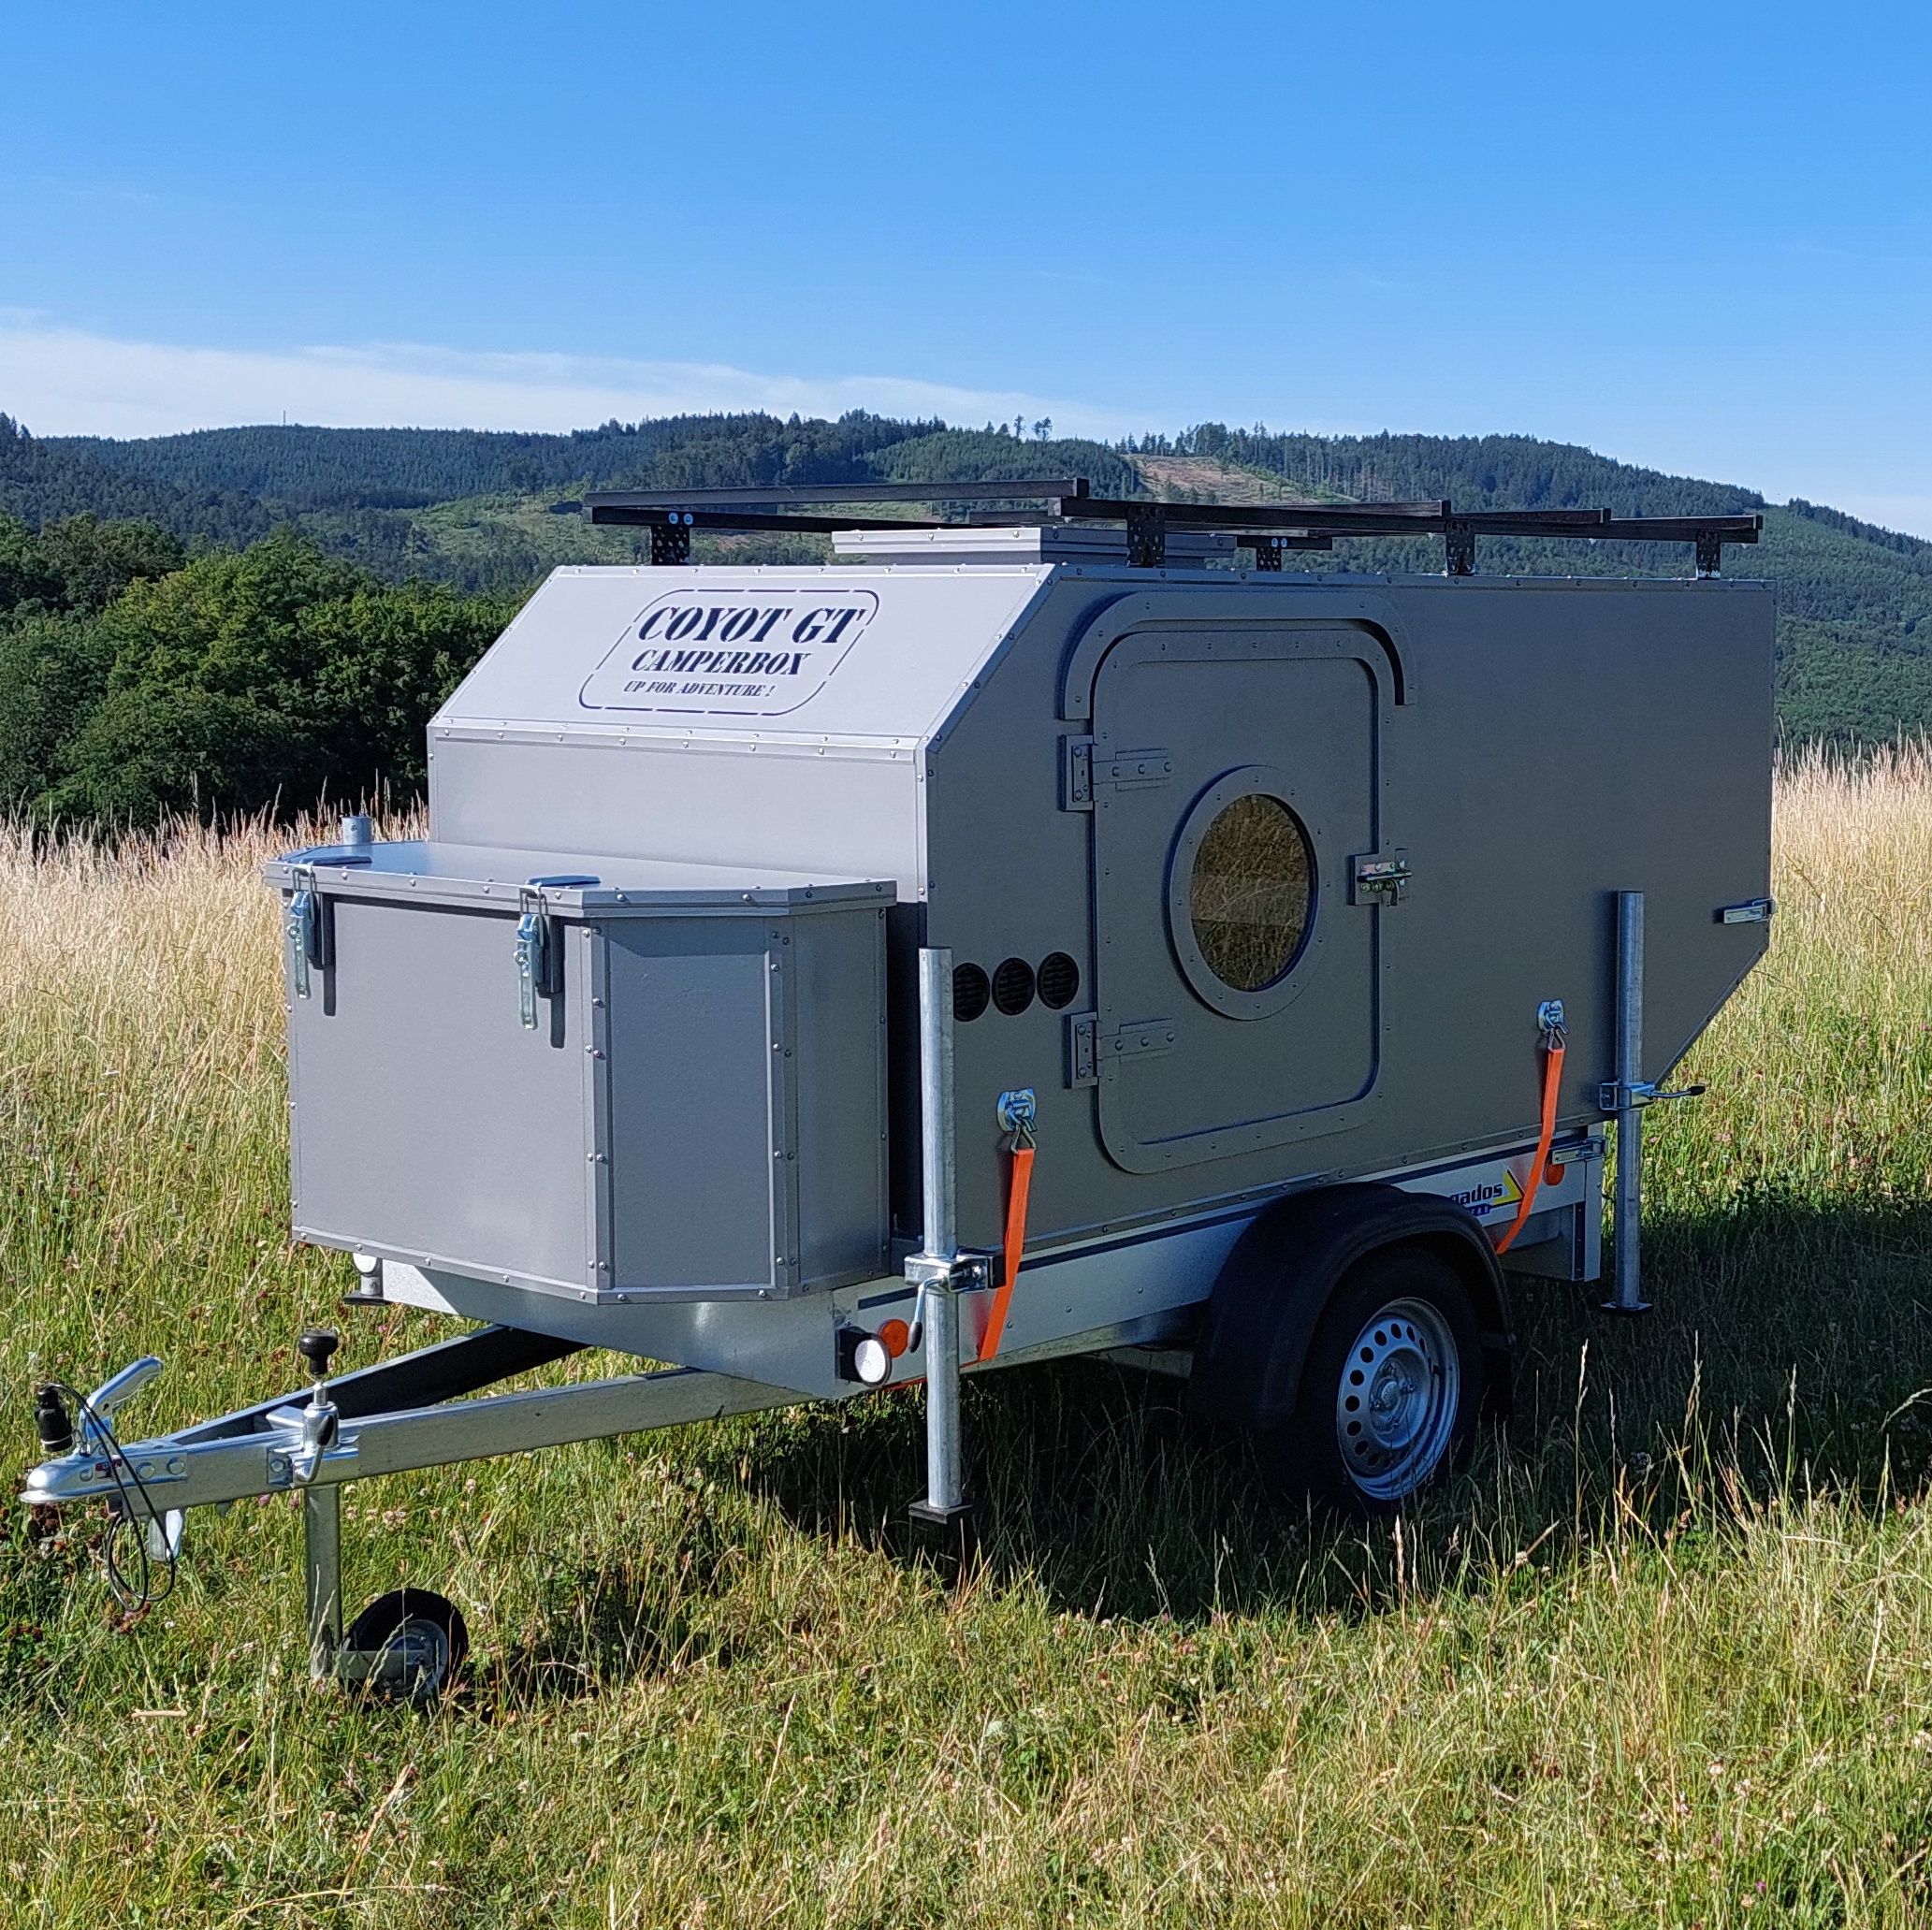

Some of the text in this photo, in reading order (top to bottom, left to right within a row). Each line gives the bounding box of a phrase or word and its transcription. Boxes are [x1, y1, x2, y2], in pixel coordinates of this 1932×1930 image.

[639, 607, 867, 643] COYOT GT
[631, 649, 812, 675] CAMPERBOX
[623, 681, 646, 692] UP
[646, 681, 676, 693] FOR
[675, 683, 766, 696] ADVENTURE
